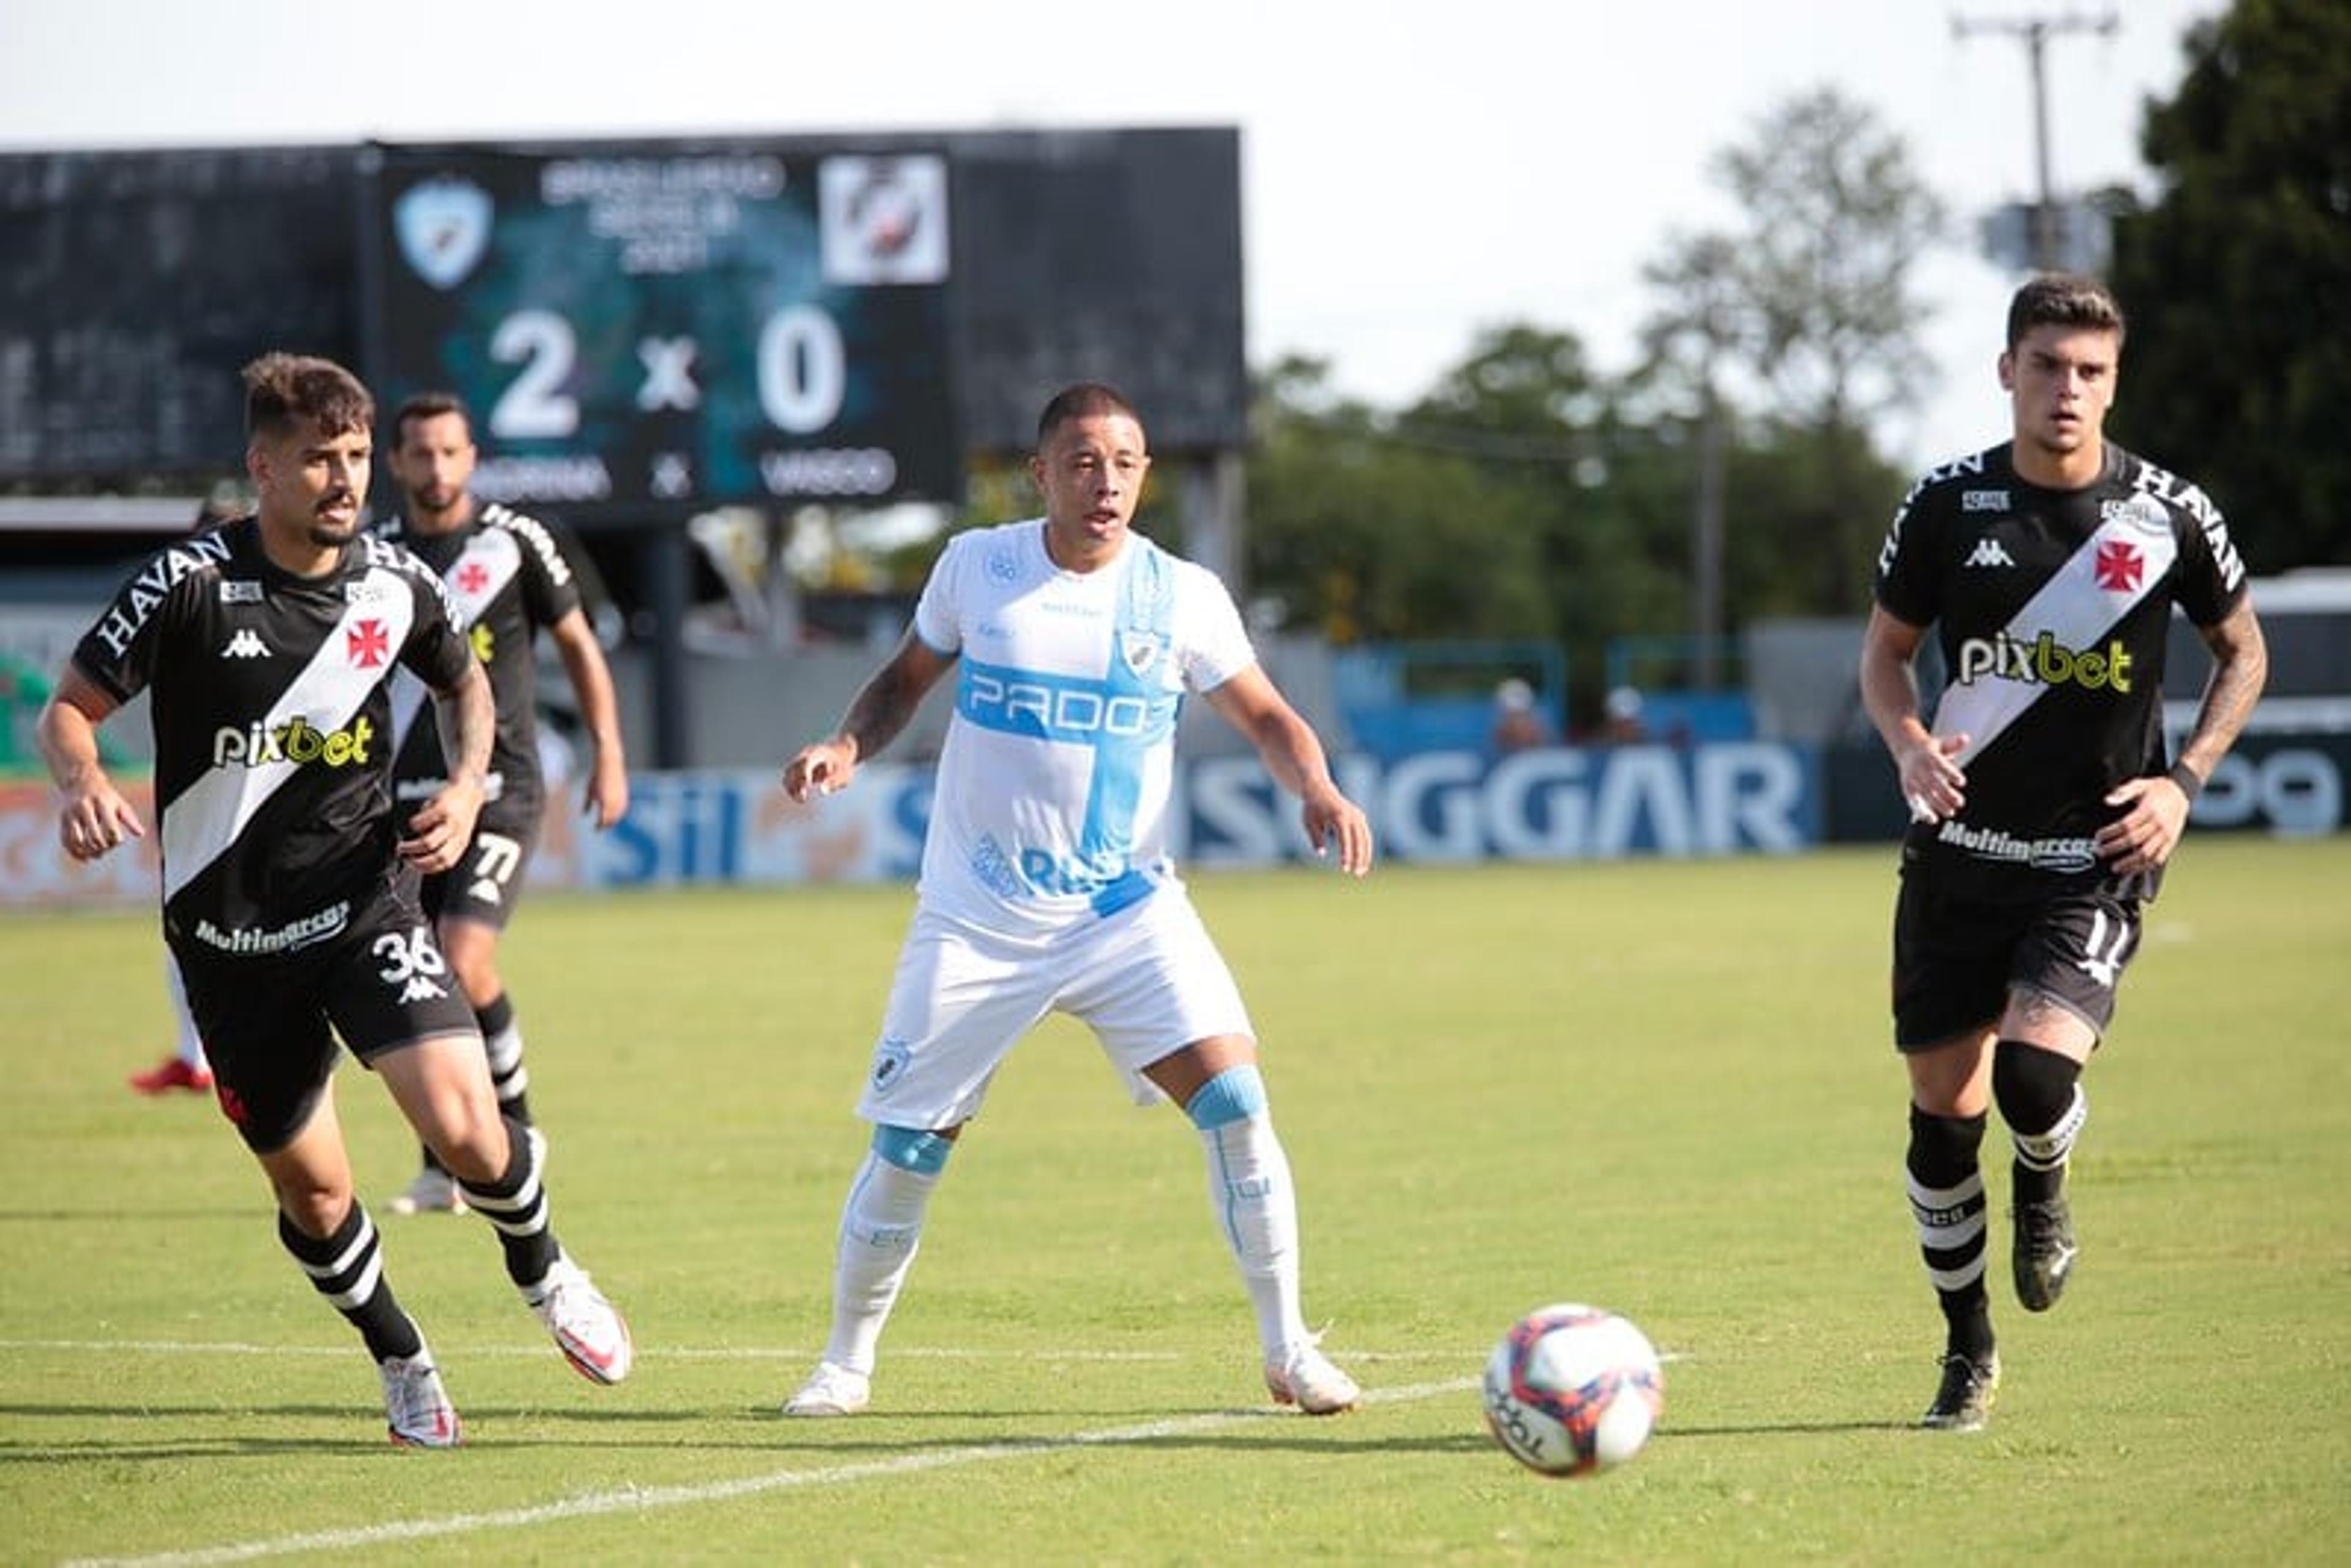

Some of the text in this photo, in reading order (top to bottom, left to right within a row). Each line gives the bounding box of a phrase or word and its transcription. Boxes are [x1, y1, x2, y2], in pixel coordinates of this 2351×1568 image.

[491, 309, 579, 438] 2
[757, 304, 846, 434] 0
[2132, 459, 2247, 592] HAVAN
[99, 531, 233, 659] HAVAN
[969, 675, 1149, 736] PADO
[1960, 629, 2133, 693] pixbet
[214, 715, 373, 769] pixbet
[1191, 746, 1805, 865] SUGGAR
[373, 926, 445, 983] 36
